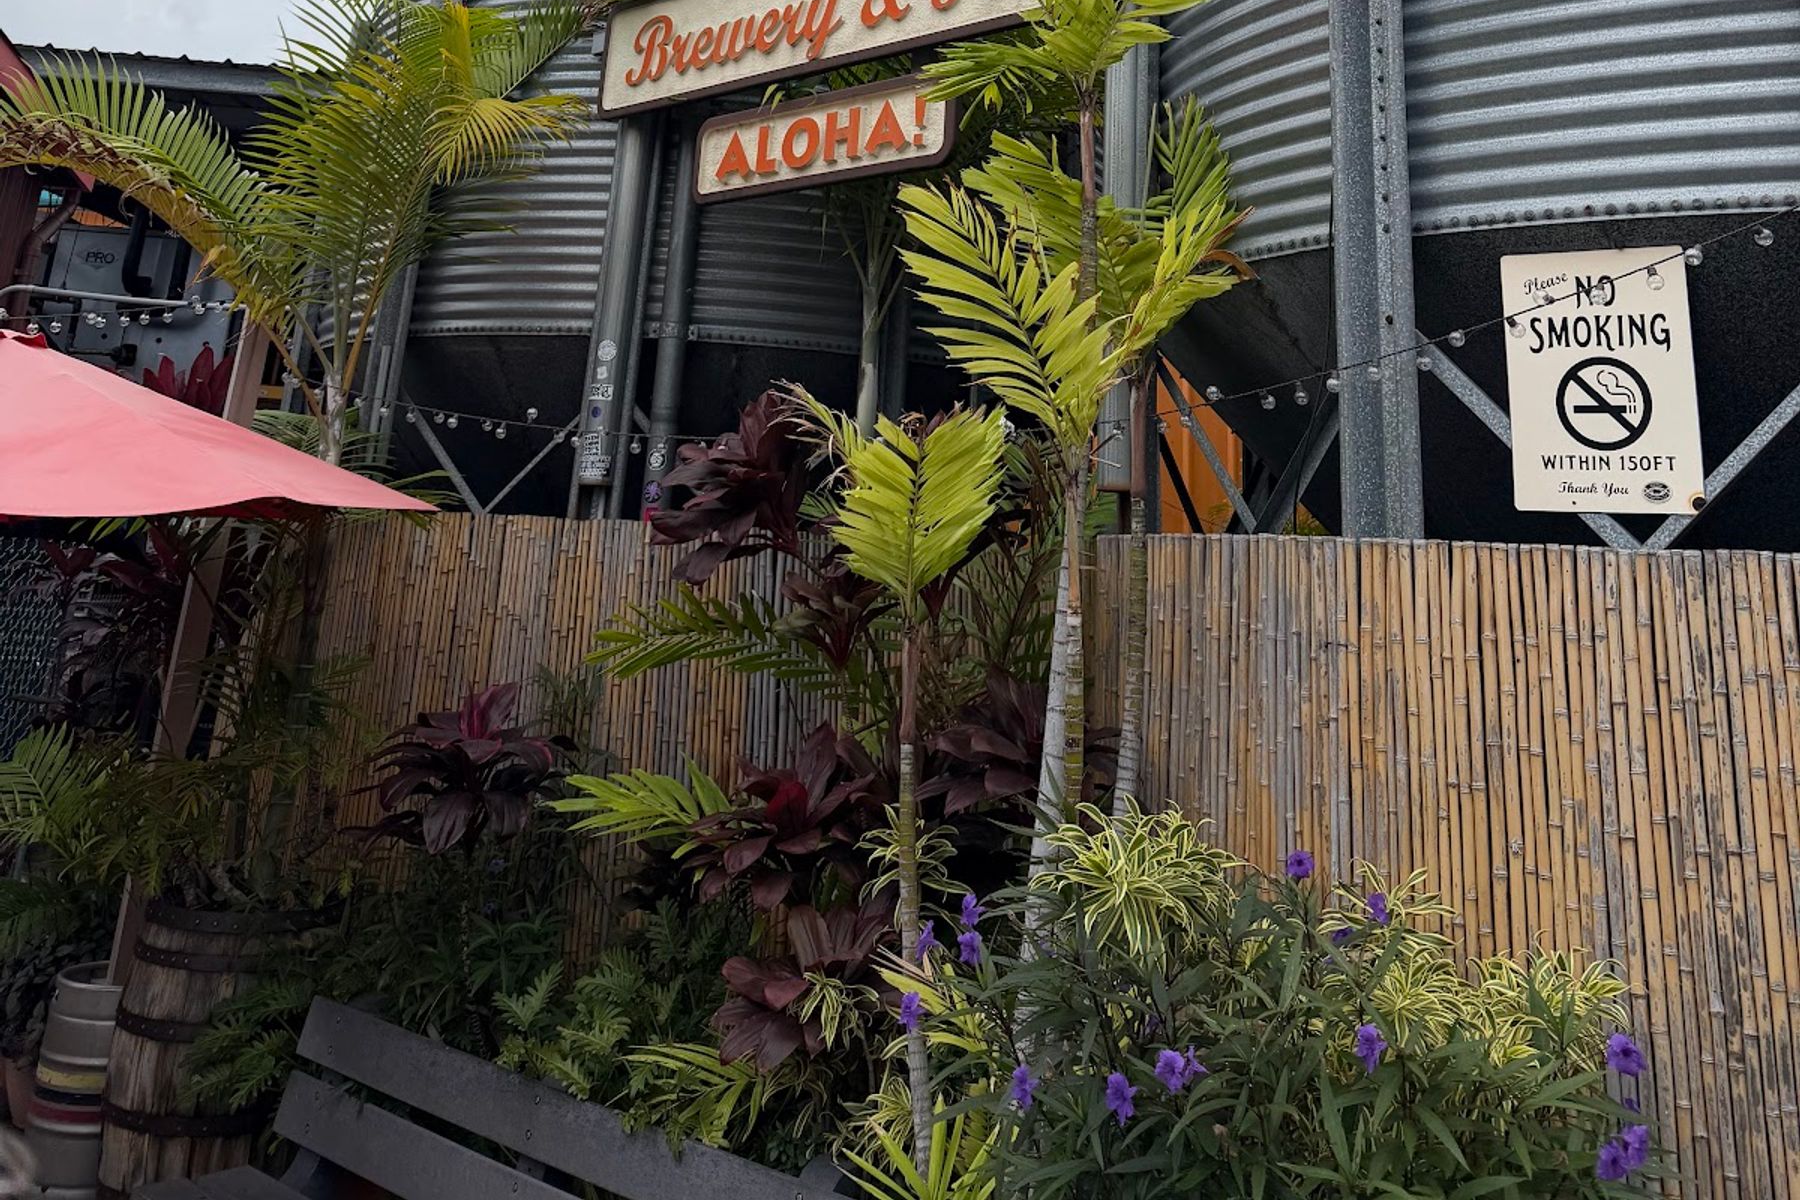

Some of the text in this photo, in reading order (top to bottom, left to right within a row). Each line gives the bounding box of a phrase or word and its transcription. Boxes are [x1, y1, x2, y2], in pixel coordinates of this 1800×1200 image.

[715, 95, 929, 182] ALOHA!
[85, 251, 115, 264] PRO
[1523, 272, 1569, 295] Please
[1574, 275, 1616, 309] NO
[1529, 313, 1671, 354] SMOKING
[1541, 454, 1676, 471] WITHIN 150FT
[1558, 481, 1598, 494] Thank
[1602, 481, 1630, 499] You
